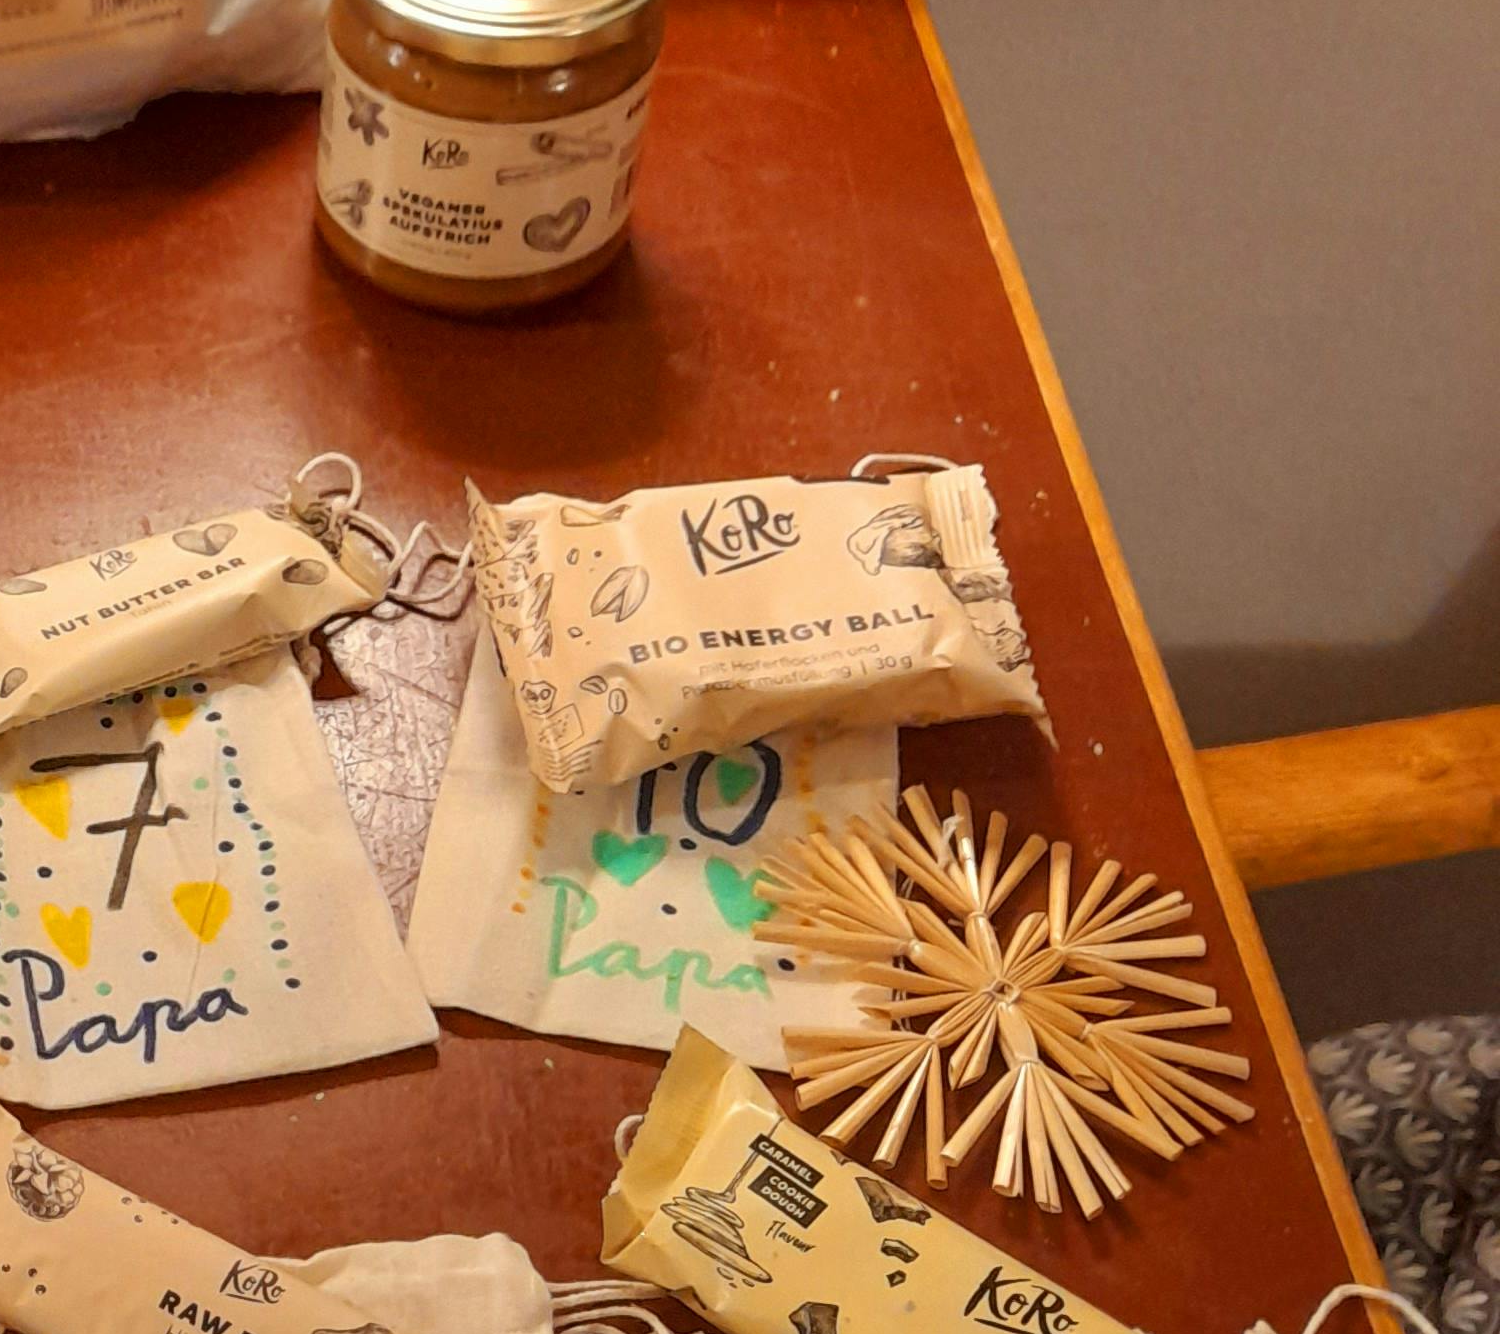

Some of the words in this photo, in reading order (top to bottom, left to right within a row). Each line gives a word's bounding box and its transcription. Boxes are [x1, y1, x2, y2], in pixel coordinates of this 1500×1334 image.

[383, 196, 503, 231] SPEKULATIUS
[399, 187, 485, 215] VEGANER
[389, 214, 490, 245] AUFSTRICH
[681, 494, 800, 576] KoRo
[89, 549, 138, 581] KoRo
[41, 614, 90, 640] NUT
[97, 578, 192, 619] BUTTER
[196, 556, 246, 581] BAR
[629, 634, 688, 665] BIO
[700, 619, 833, 650] ENERGY
[847, 603, 934, 633] BALL
[29, 742, 189, 911] 7
[541, 875, 773, 1013] Papa
[1, 949, 249, 1064] Papa
[758, 1141, 813, 1182] CARAMEL
[760, 1185, 806, 1219] DOUGH
[769, 1175, 817, 1211] COOKIE
[220, 1259, 286, 1304] KoRo
